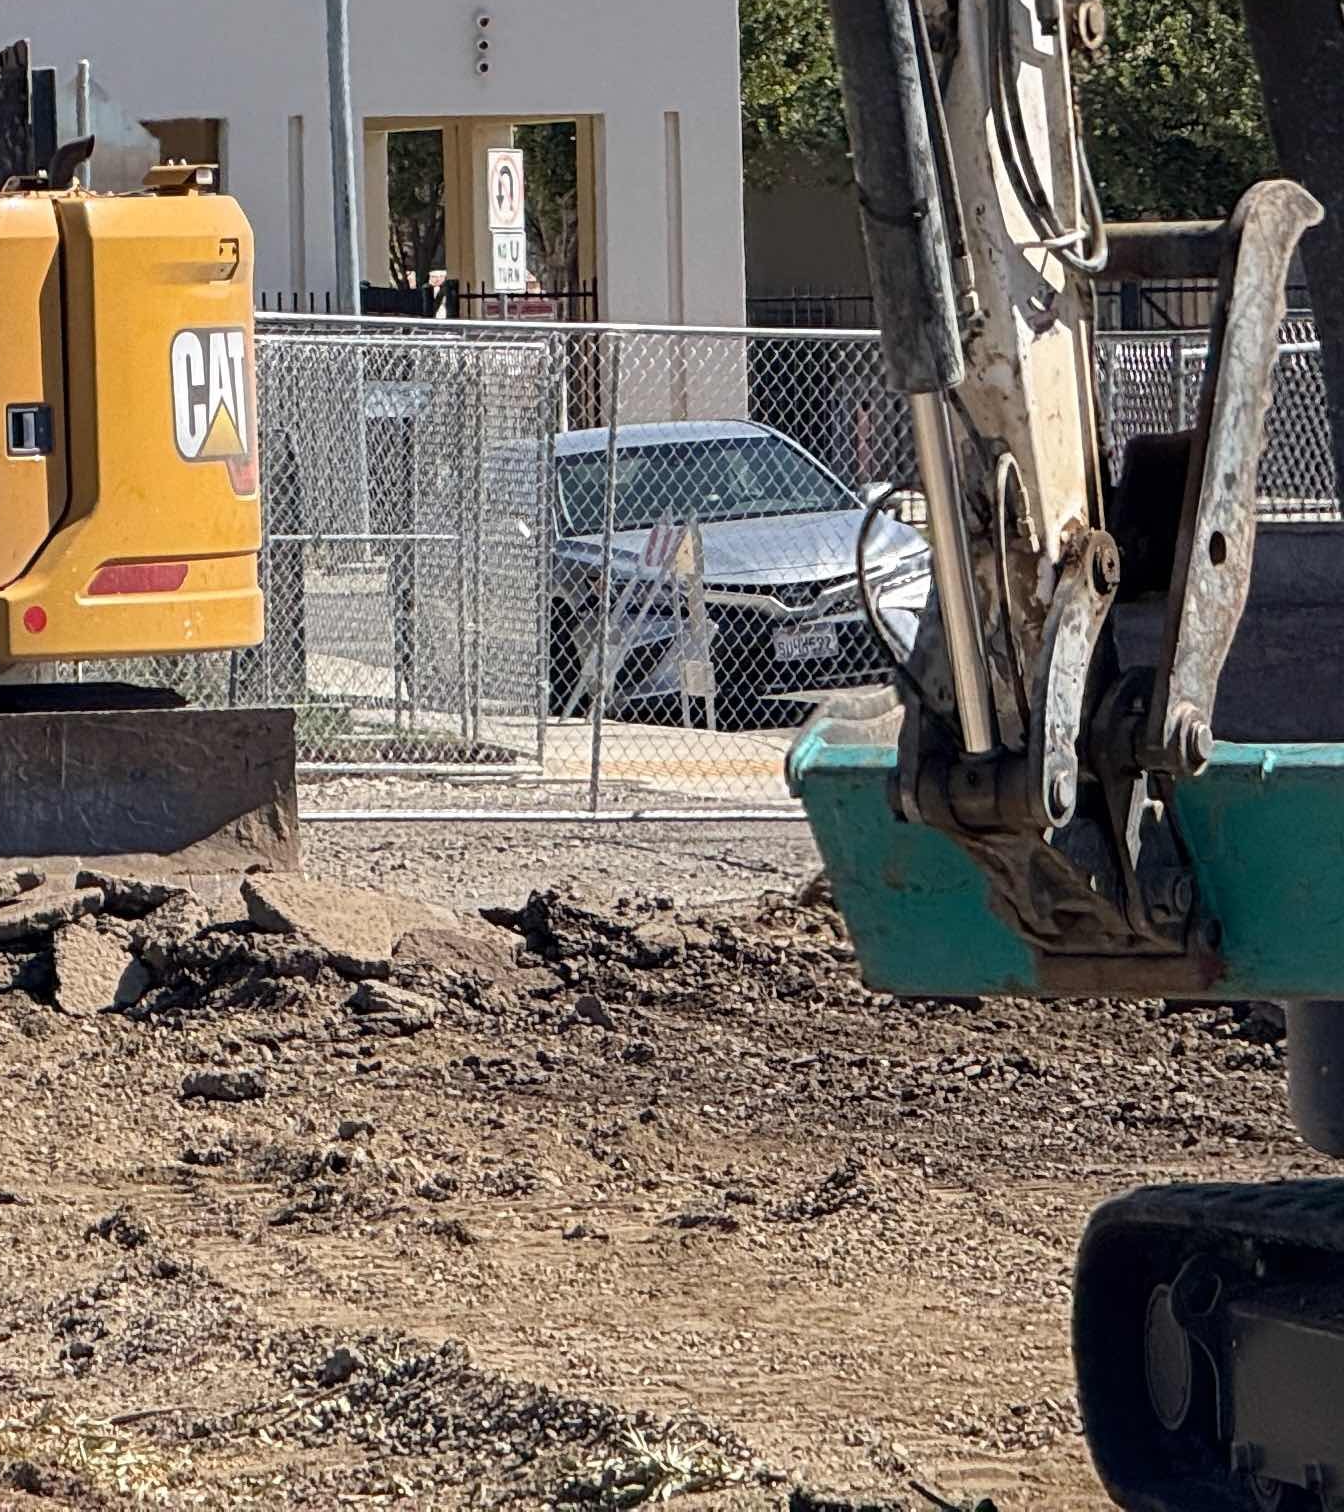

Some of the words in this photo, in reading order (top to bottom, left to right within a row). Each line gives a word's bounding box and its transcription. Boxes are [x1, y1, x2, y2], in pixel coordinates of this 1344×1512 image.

[509, 240, 519, 262] U
[498, 267, 520, 282] TURN
[171, 331, 248, 458] CAT
